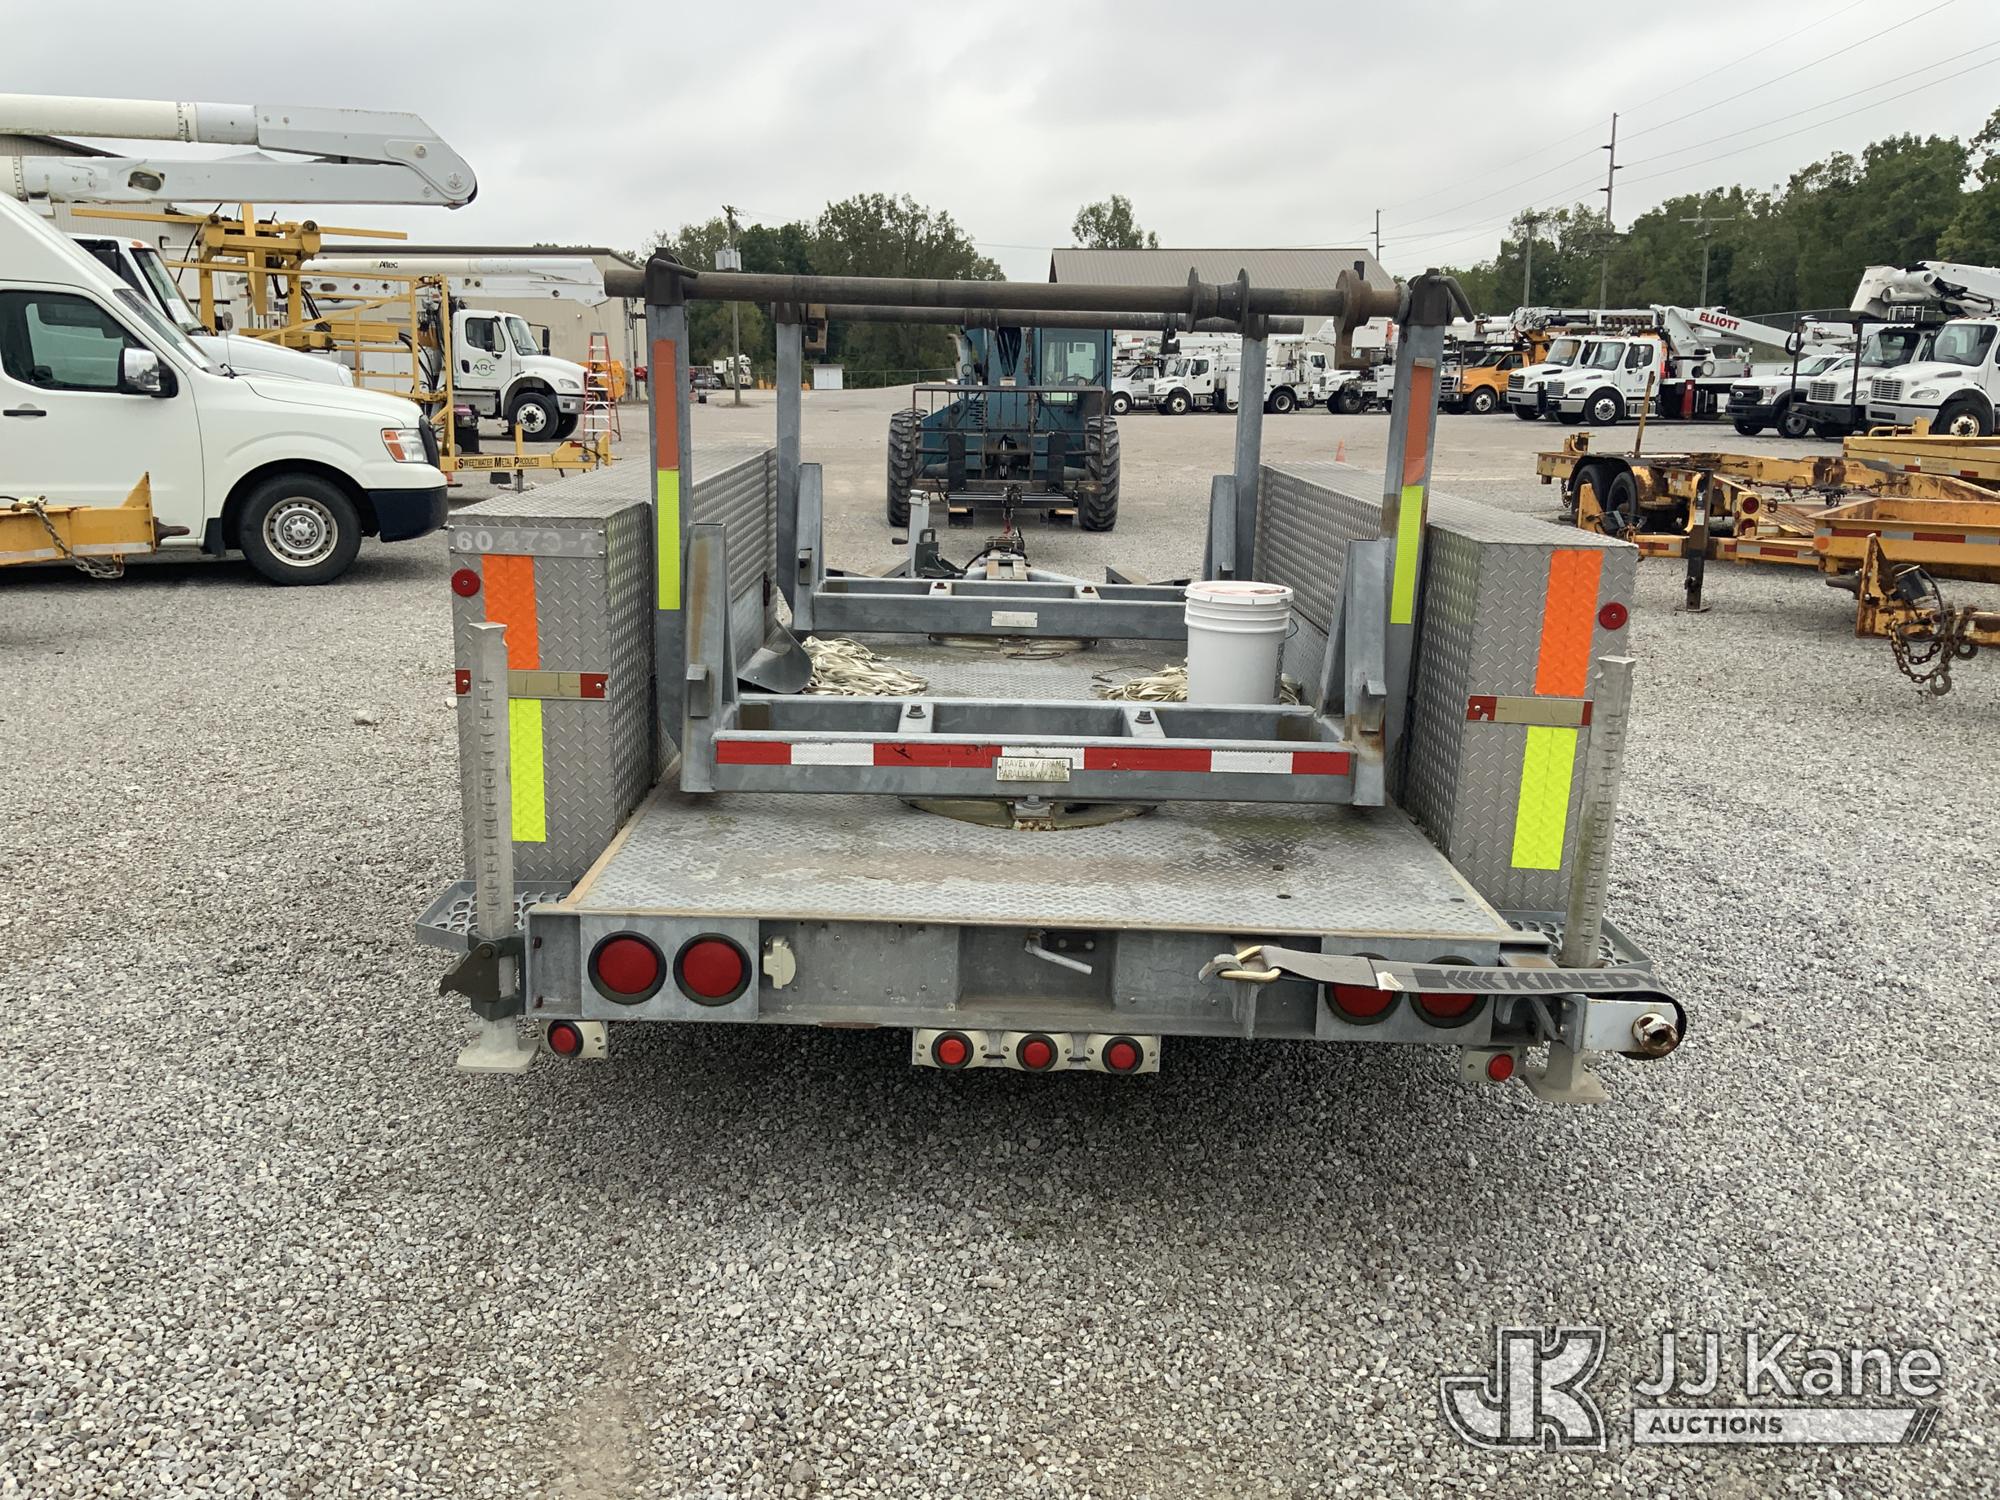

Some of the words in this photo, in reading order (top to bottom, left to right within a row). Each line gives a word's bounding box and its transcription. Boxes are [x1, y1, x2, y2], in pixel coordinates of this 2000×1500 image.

[379, 260, 399, 269] Altec
[1699, 312, 1740, 331] ELLIOTT
[472, 363, 496, 371] ARC
[1000, 758, 1027, 768] TRAVEL
[1042, 760, 1067, 769] FRAME
